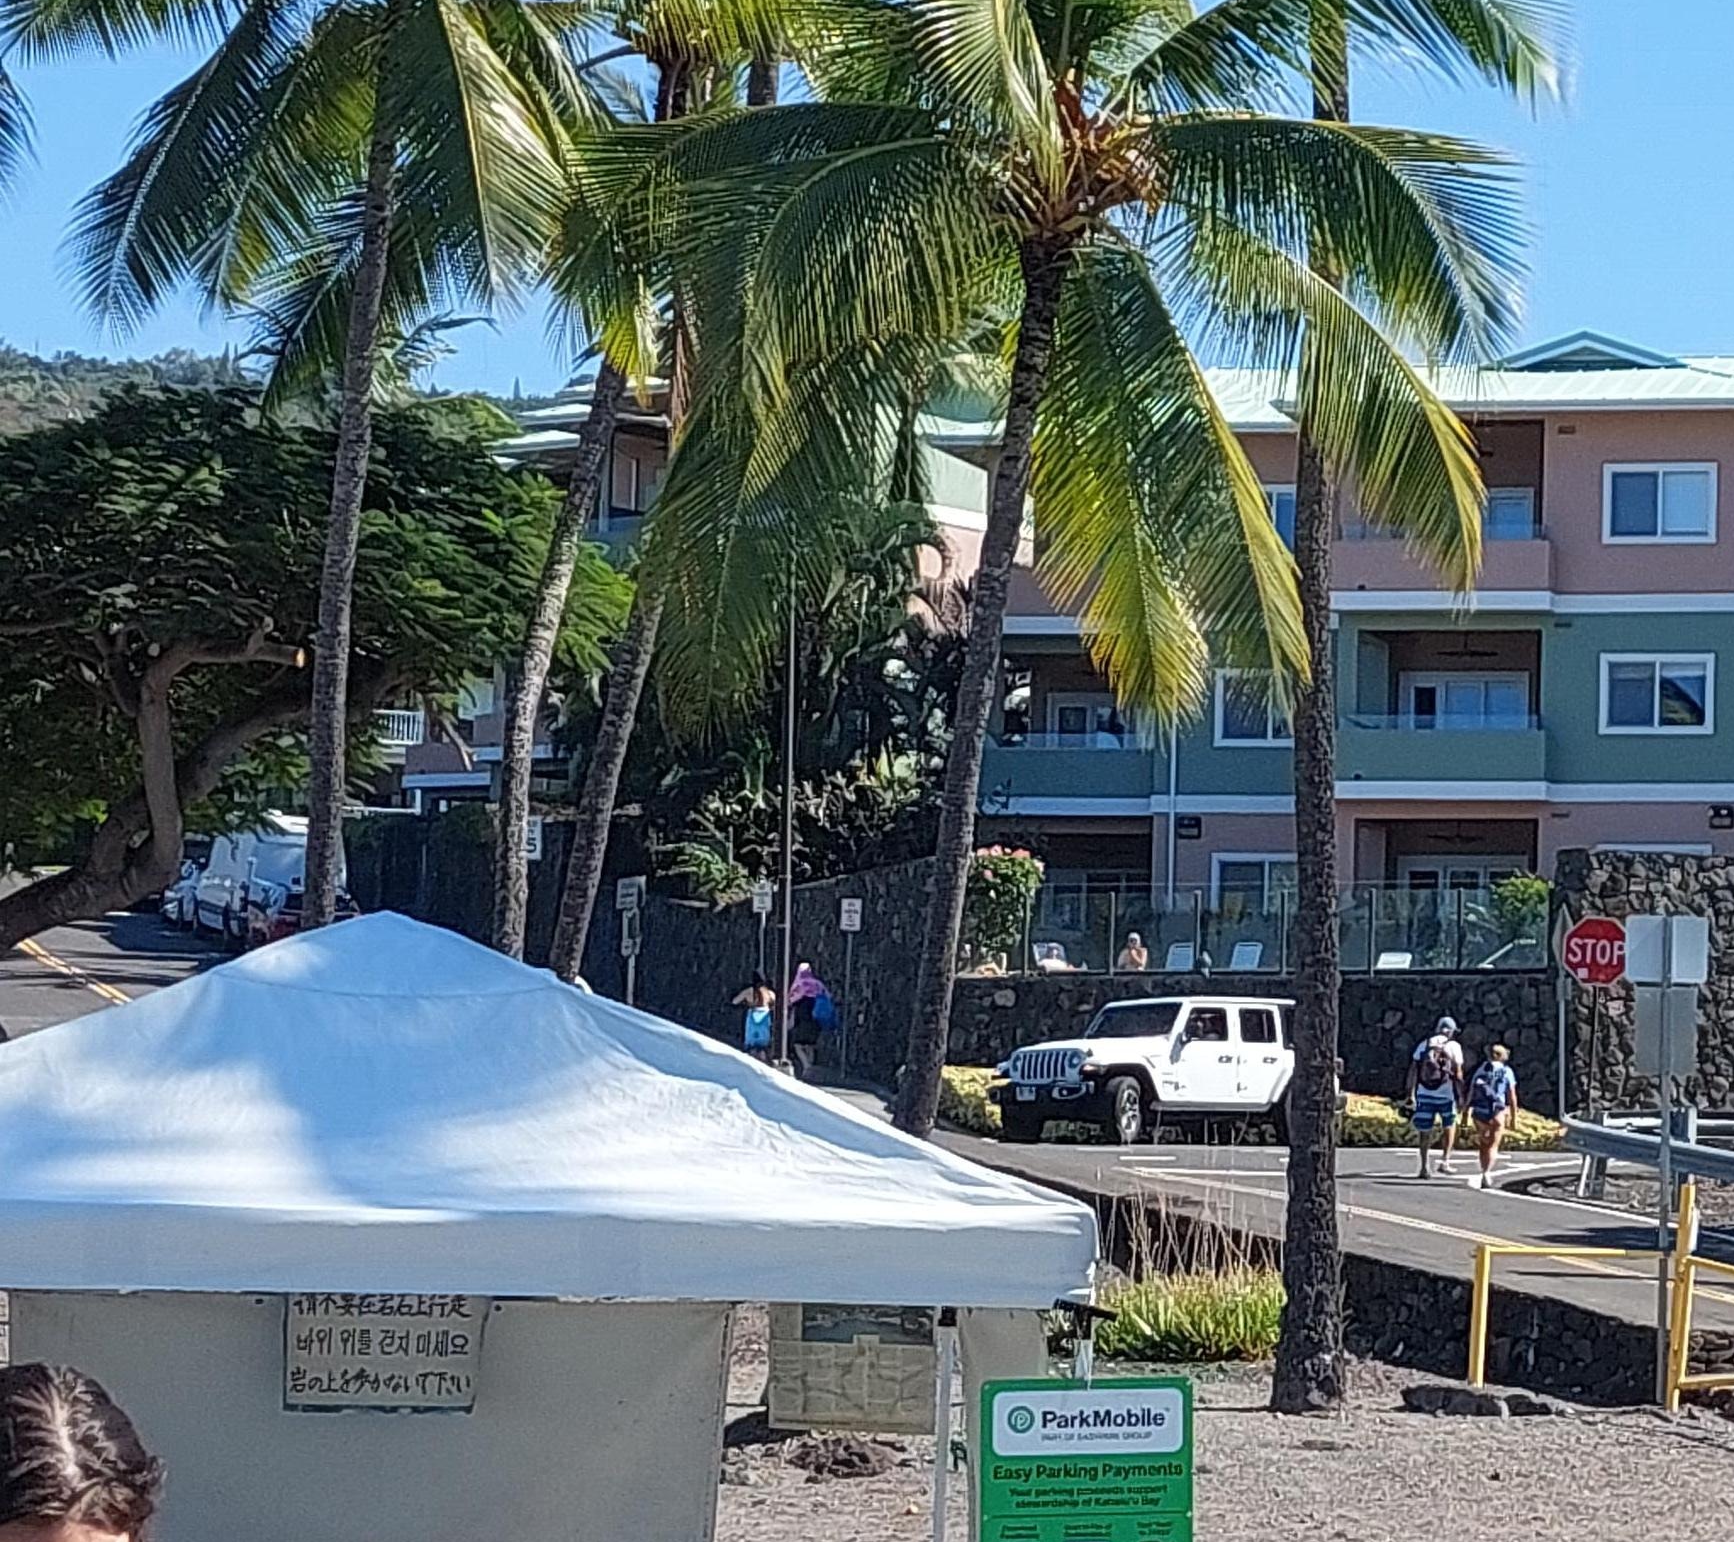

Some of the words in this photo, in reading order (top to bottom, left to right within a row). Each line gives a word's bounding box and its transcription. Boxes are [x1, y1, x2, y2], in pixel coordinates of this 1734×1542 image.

[1568, 937, 1626, 965] STOP
[296, 1327, 333, 1356] 바위
[340, 1328, 372, 1356] 위를
[1041, 1408, 1166, 1429] ParkMobile
[993, 1465, 1033, 1483] Easy
[1036, 1463, 1099, 1482] Parking
[1102, 1462, 1183, 1481] Payments
